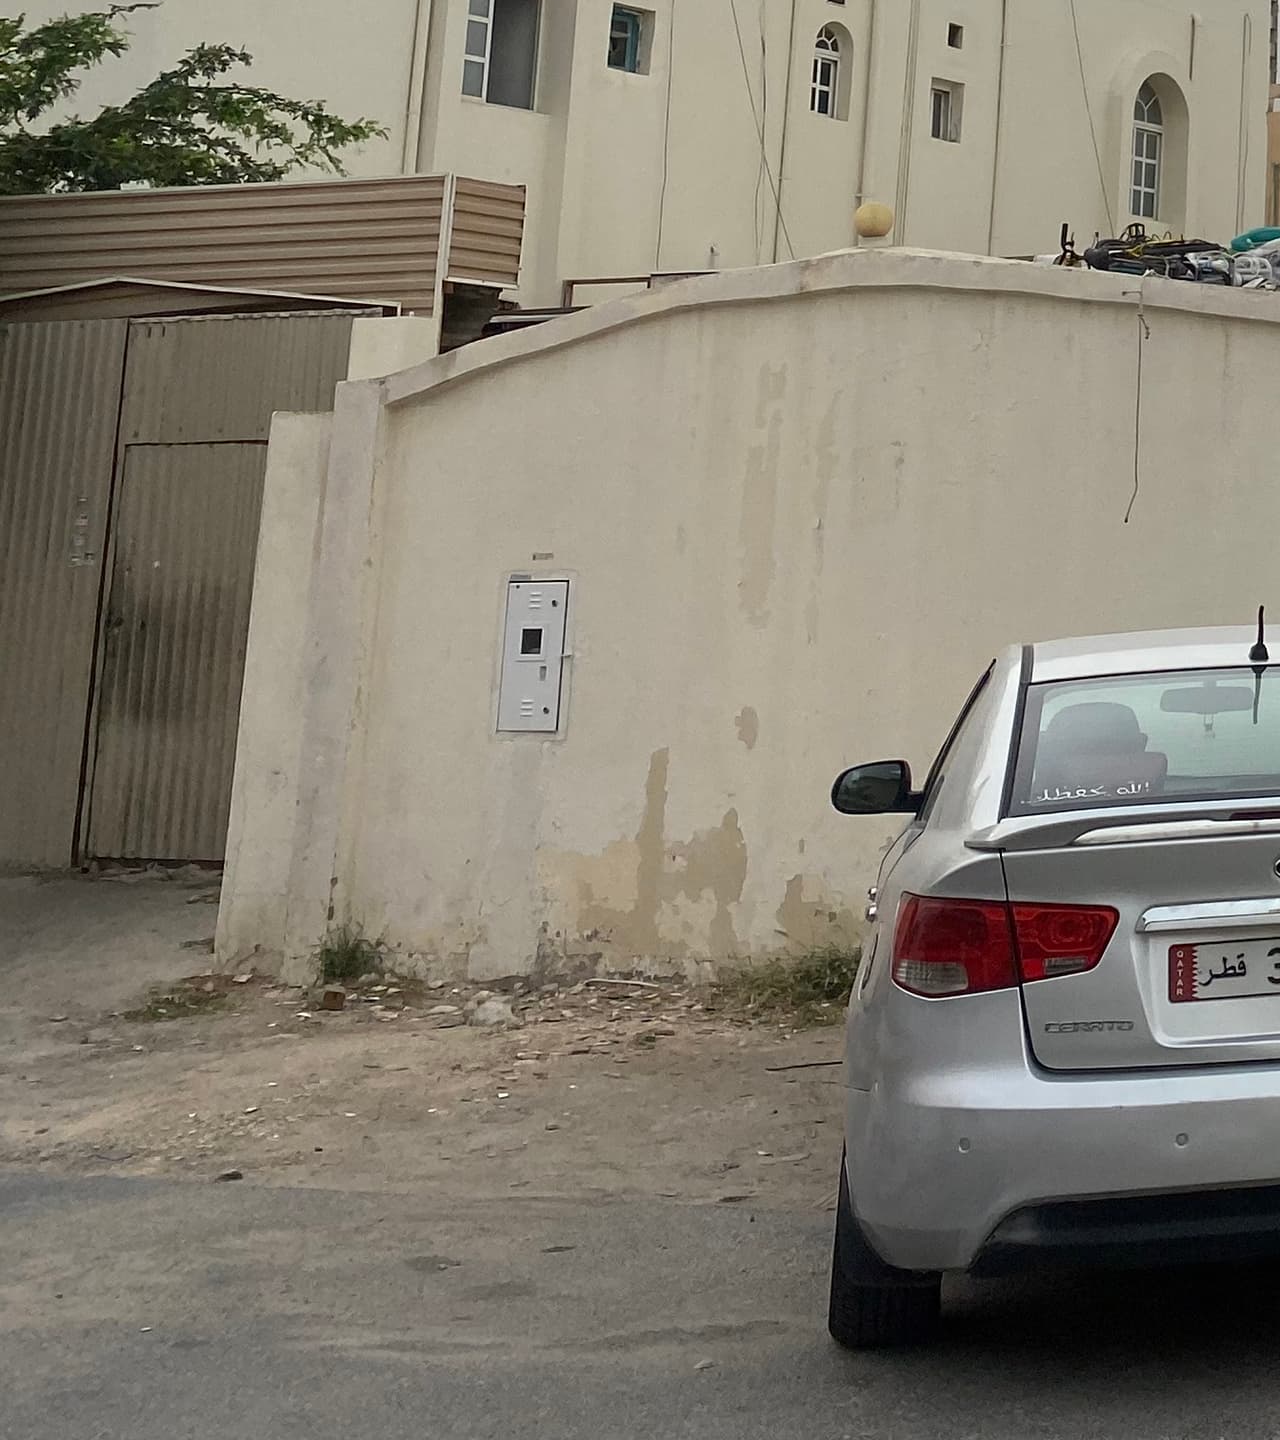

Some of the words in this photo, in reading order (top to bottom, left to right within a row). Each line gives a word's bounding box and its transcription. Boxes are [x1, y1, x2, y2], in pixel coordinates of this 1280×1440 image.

[1176, 950, 1184, 996] QATAR
[1199, 952, 1247, 986] قطر
[1044, 1020, 1135, 1034] CERATO
